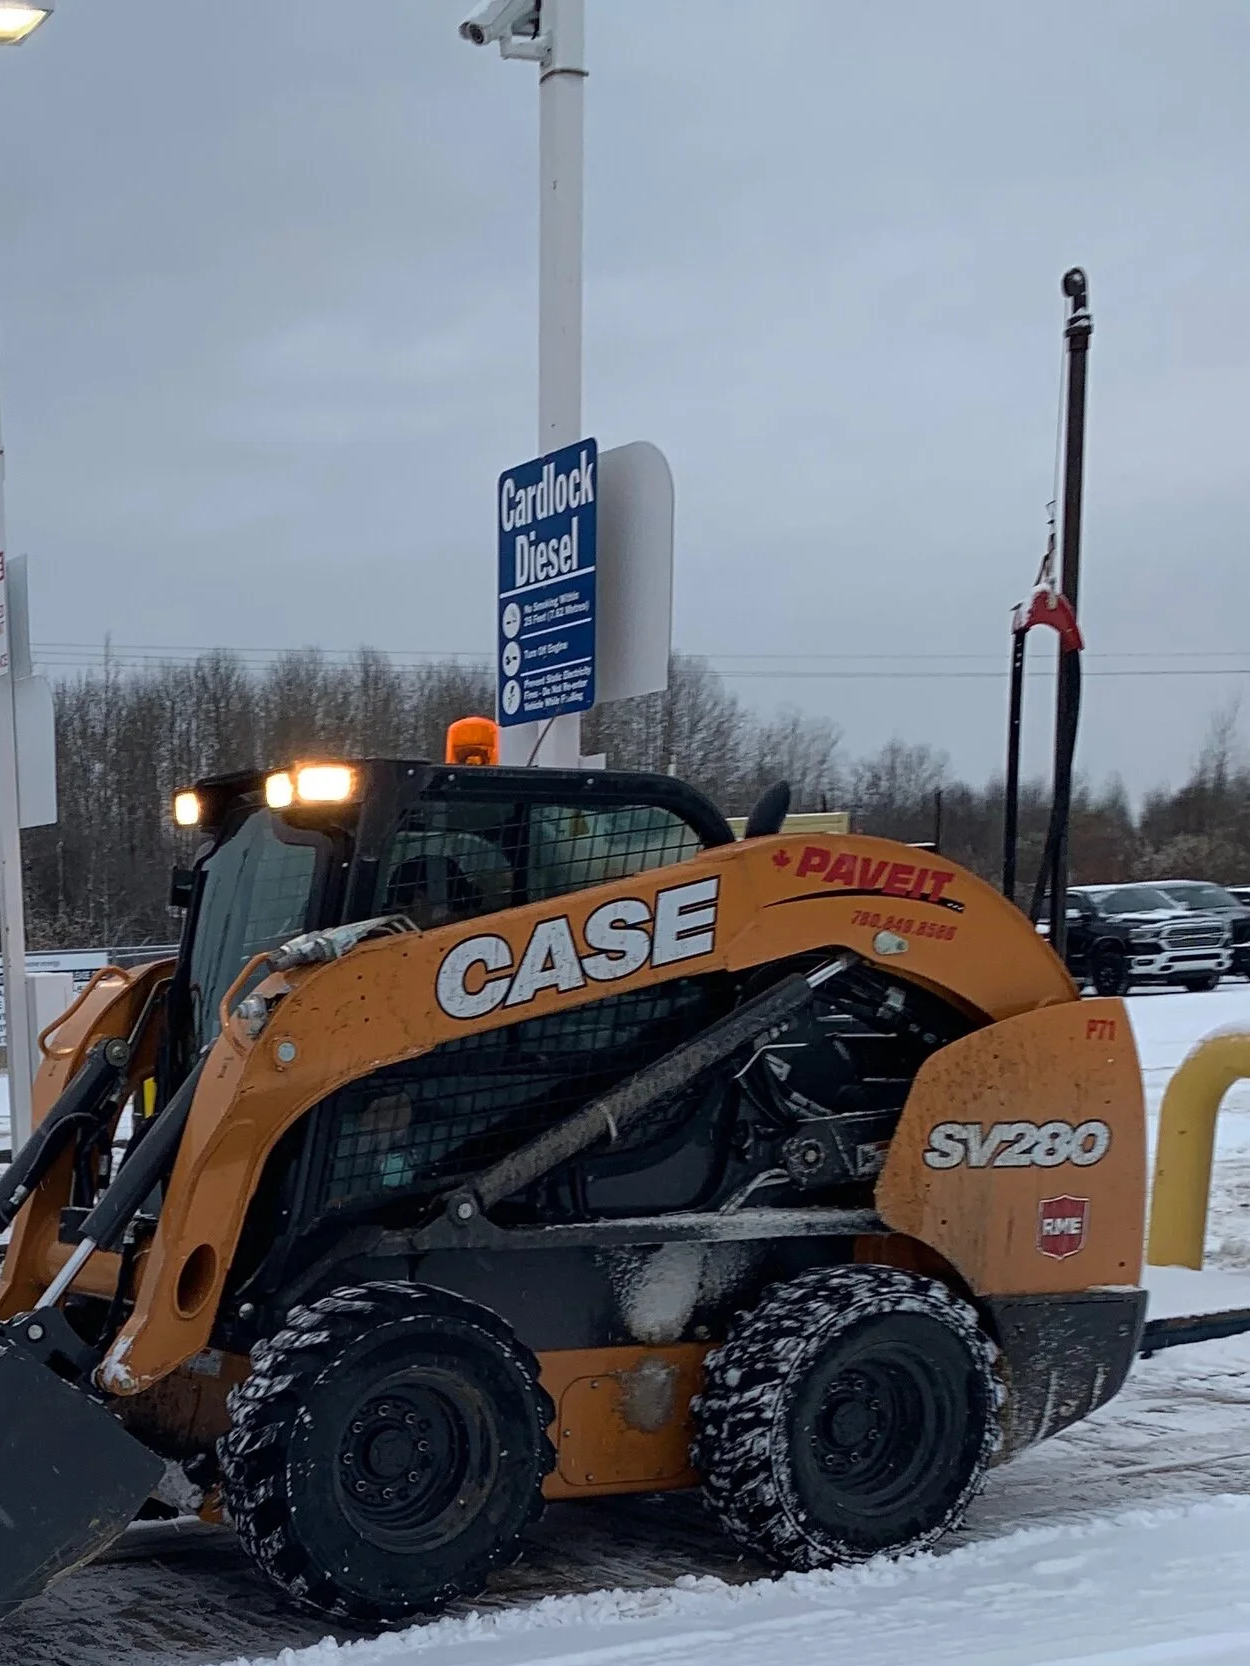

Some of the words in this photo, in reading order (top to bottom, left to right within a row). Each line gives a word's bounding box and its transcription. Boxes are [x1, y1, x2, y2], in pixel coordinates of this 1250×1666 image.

[502, 449, 595, 533] Cardlock
[515, 516, 579, 588] Diesel
[795, 846, 956, 901] PAVEIT
[435, 875, 721, 1020] CASE
[922, 1119, 1112, 1170] SV280
[1041, 1216, 1083, 1236] RME
